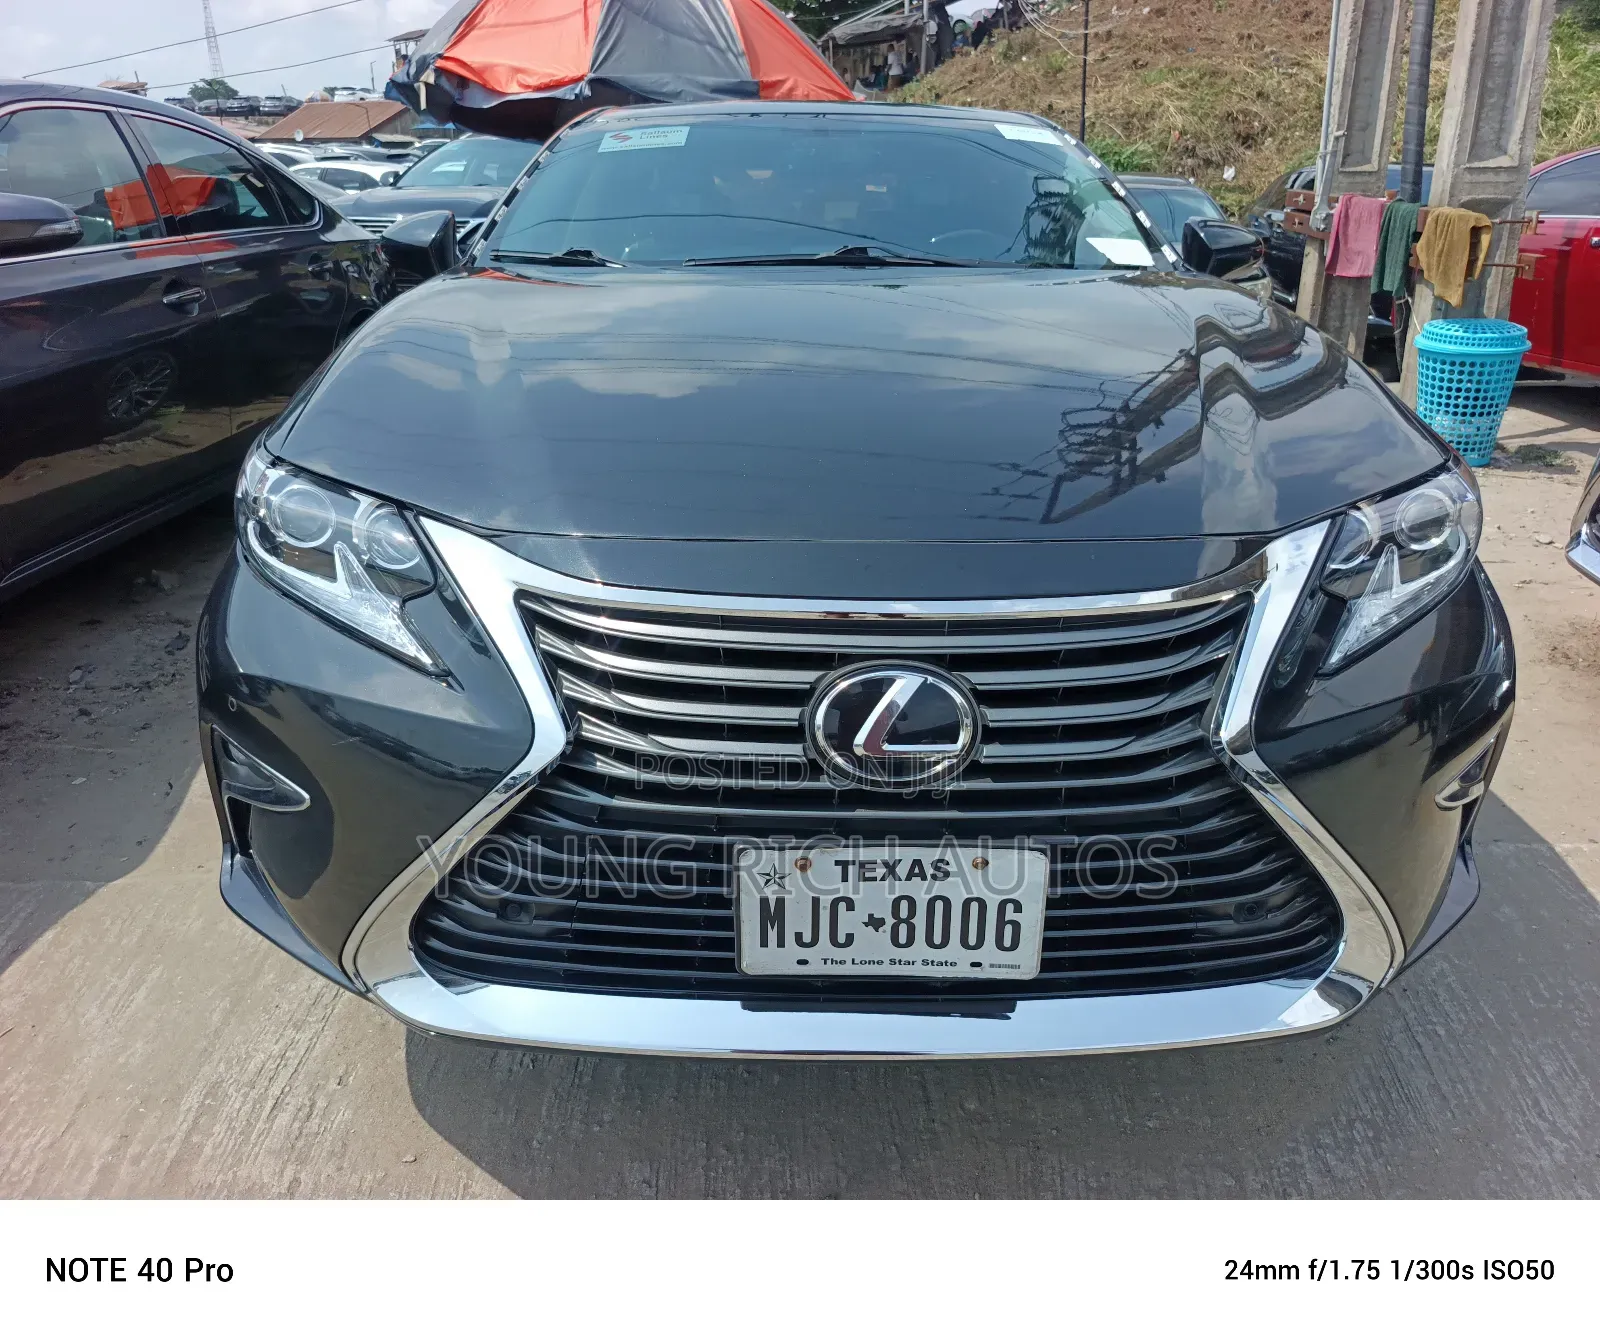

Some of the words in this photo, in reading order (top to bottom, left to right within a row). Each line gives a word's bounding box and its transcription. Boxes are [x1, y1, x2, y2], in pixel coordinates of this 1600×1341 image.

[834, 859, 951, 882] TEXAS
[821, 958, 848, 966] The
[851, 958, 883, 967] Lone
[889, 958, 917, 967] Star
[921, 958, 958, 968] State
